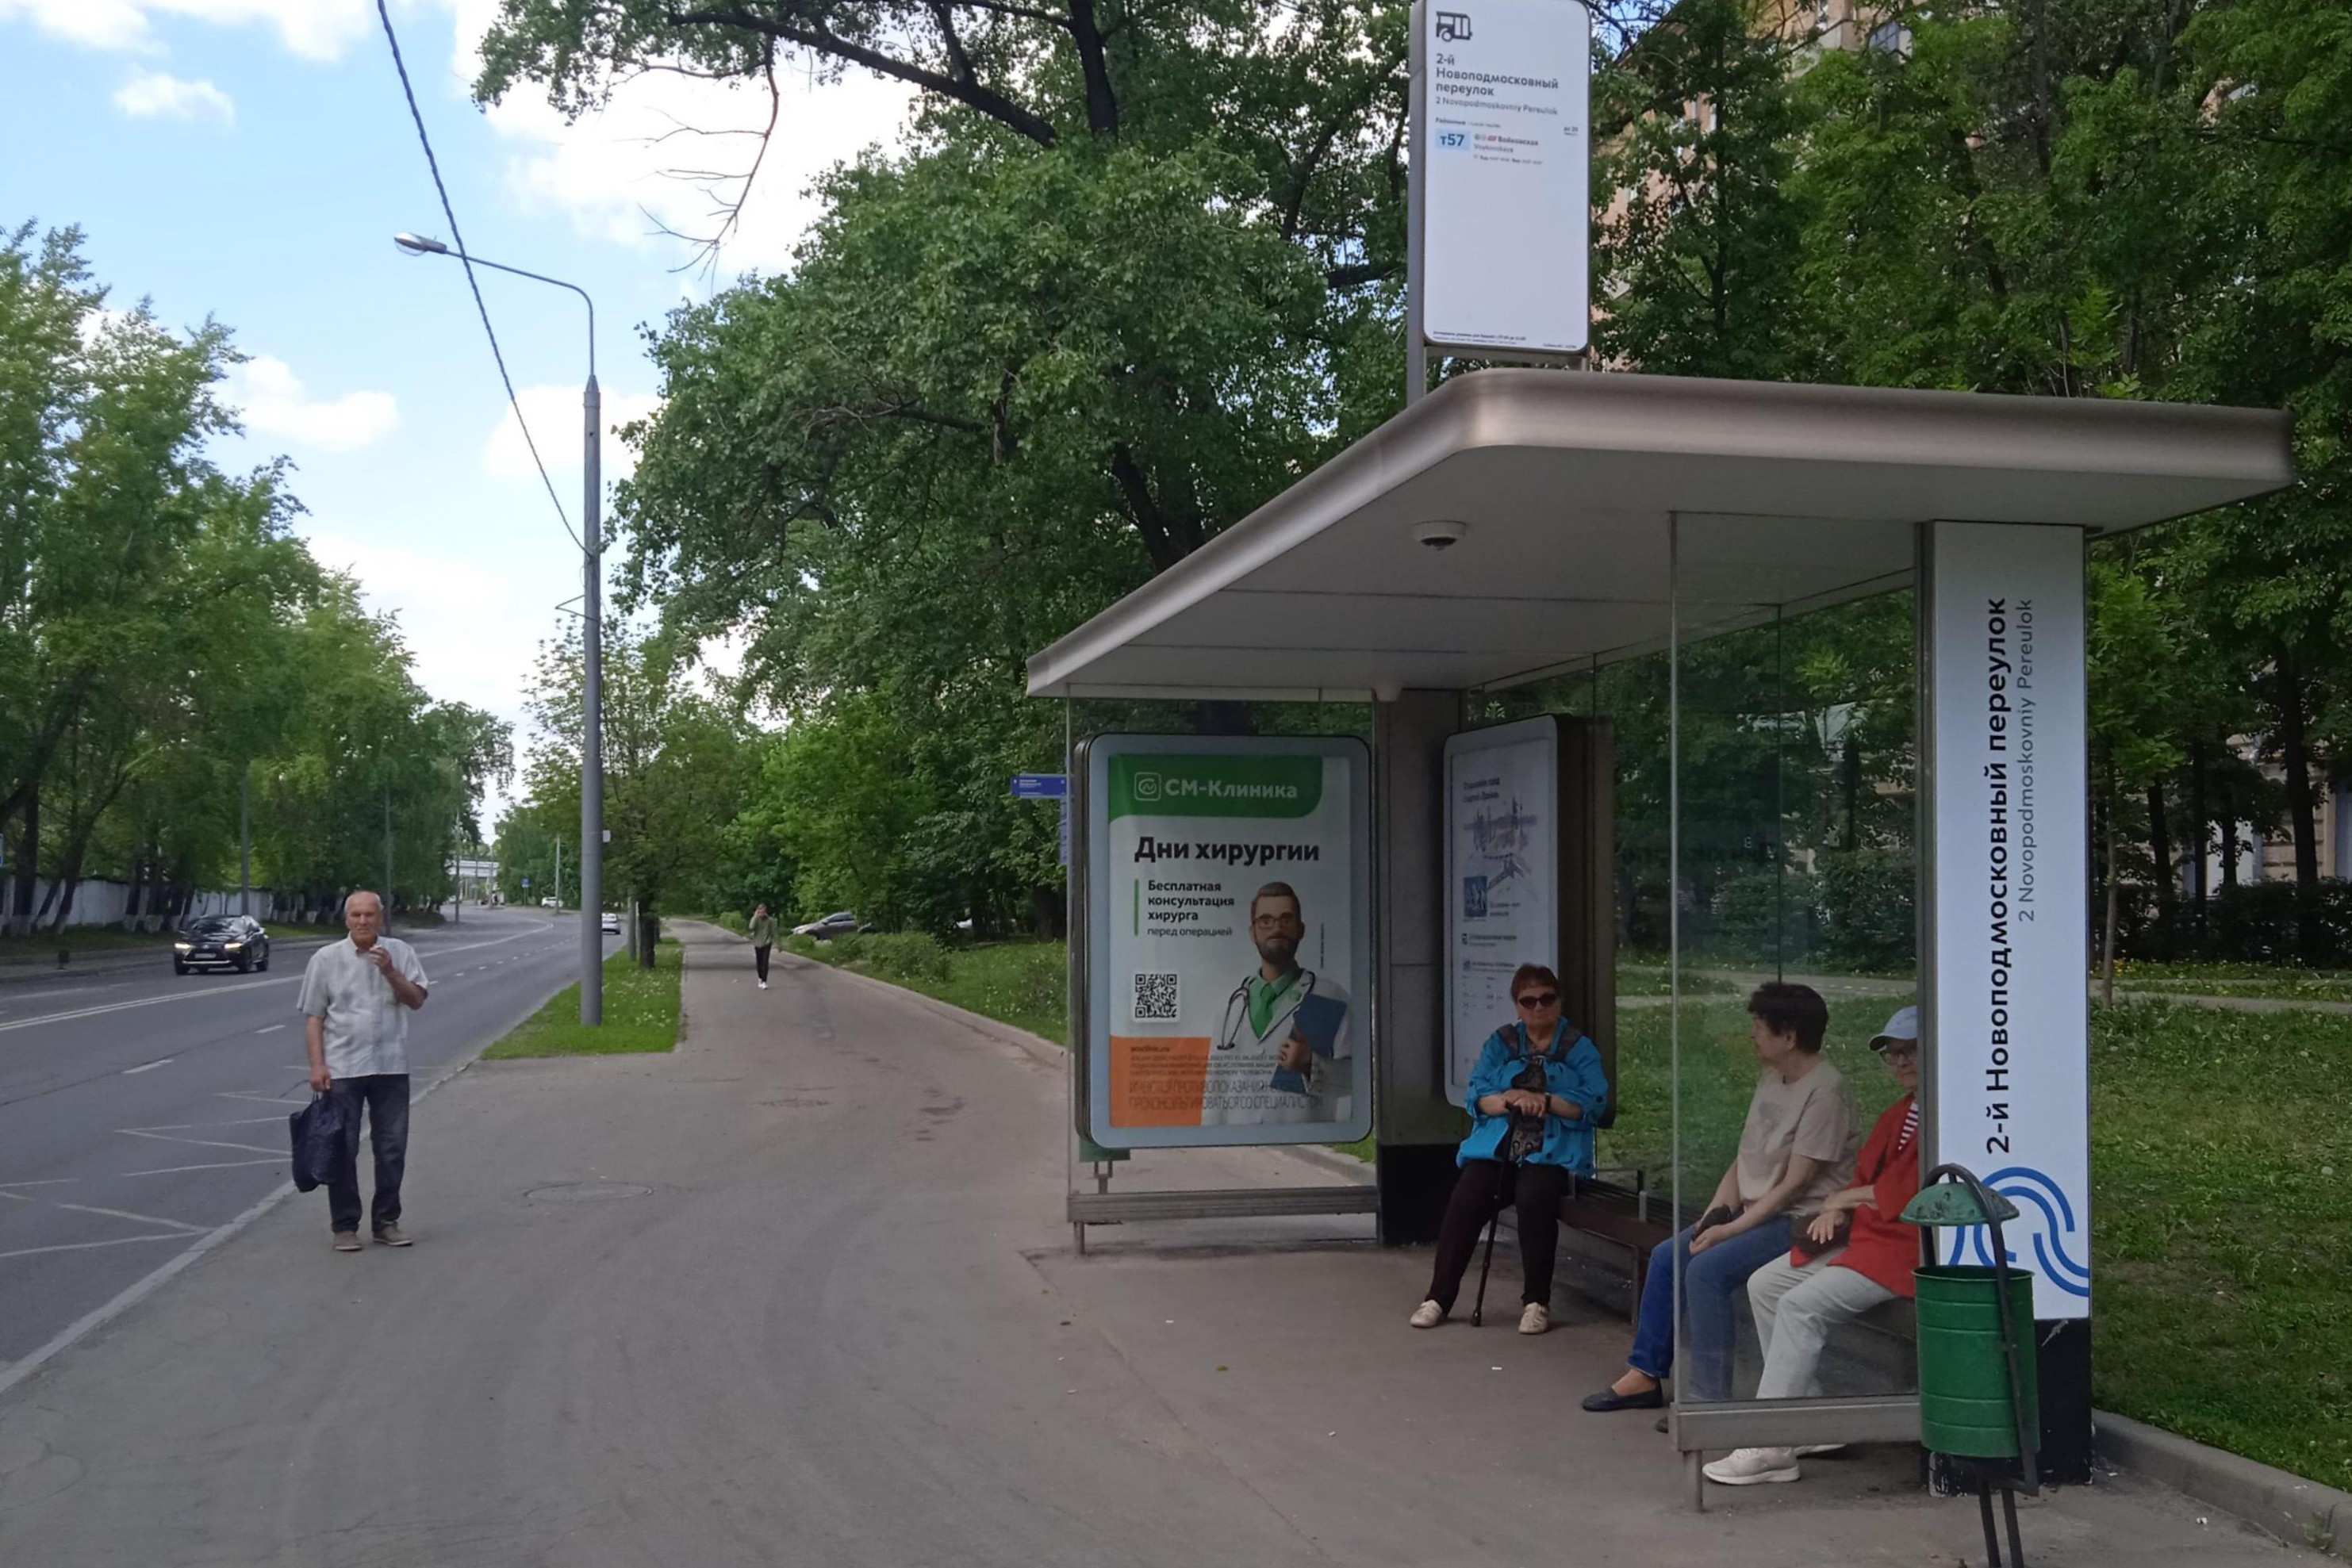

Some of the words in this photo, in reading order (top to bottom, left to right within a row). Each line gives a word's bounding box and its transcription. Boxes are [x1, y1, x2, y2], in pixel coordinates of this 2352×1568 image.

[1436, 53, 1455, 66] 2-й
[1436, 67, 1559, 89] Новоподмосковный
[1436, 82, 1494, 98] переулок
[2016, 600, 2033, 688] Pereulok
[1986, 598, 2011, 750] переулок
[1164, 779, 1298, 799] СМ-Клиника
[2016, 697, 2037, 903] Novopodmoskovniy
[1134, 837, 1189, 862] Дни
[1195, 842, 1319, 866] хирургии
[1148, 880, 1221, 892] Бесплатная
[1148, 895, 1234, 908] консультация
[1148, 911, 1199, 922] хирурга
[2019, 911, 2033, 922] 2
[1148, 927, 1177, 937] перед
[1180, 926, 1233, 937] операцией
[1984, 763, 2013, 1091] Новоподмосковный
[1986, 1103, 2010, 1154] 2-й
